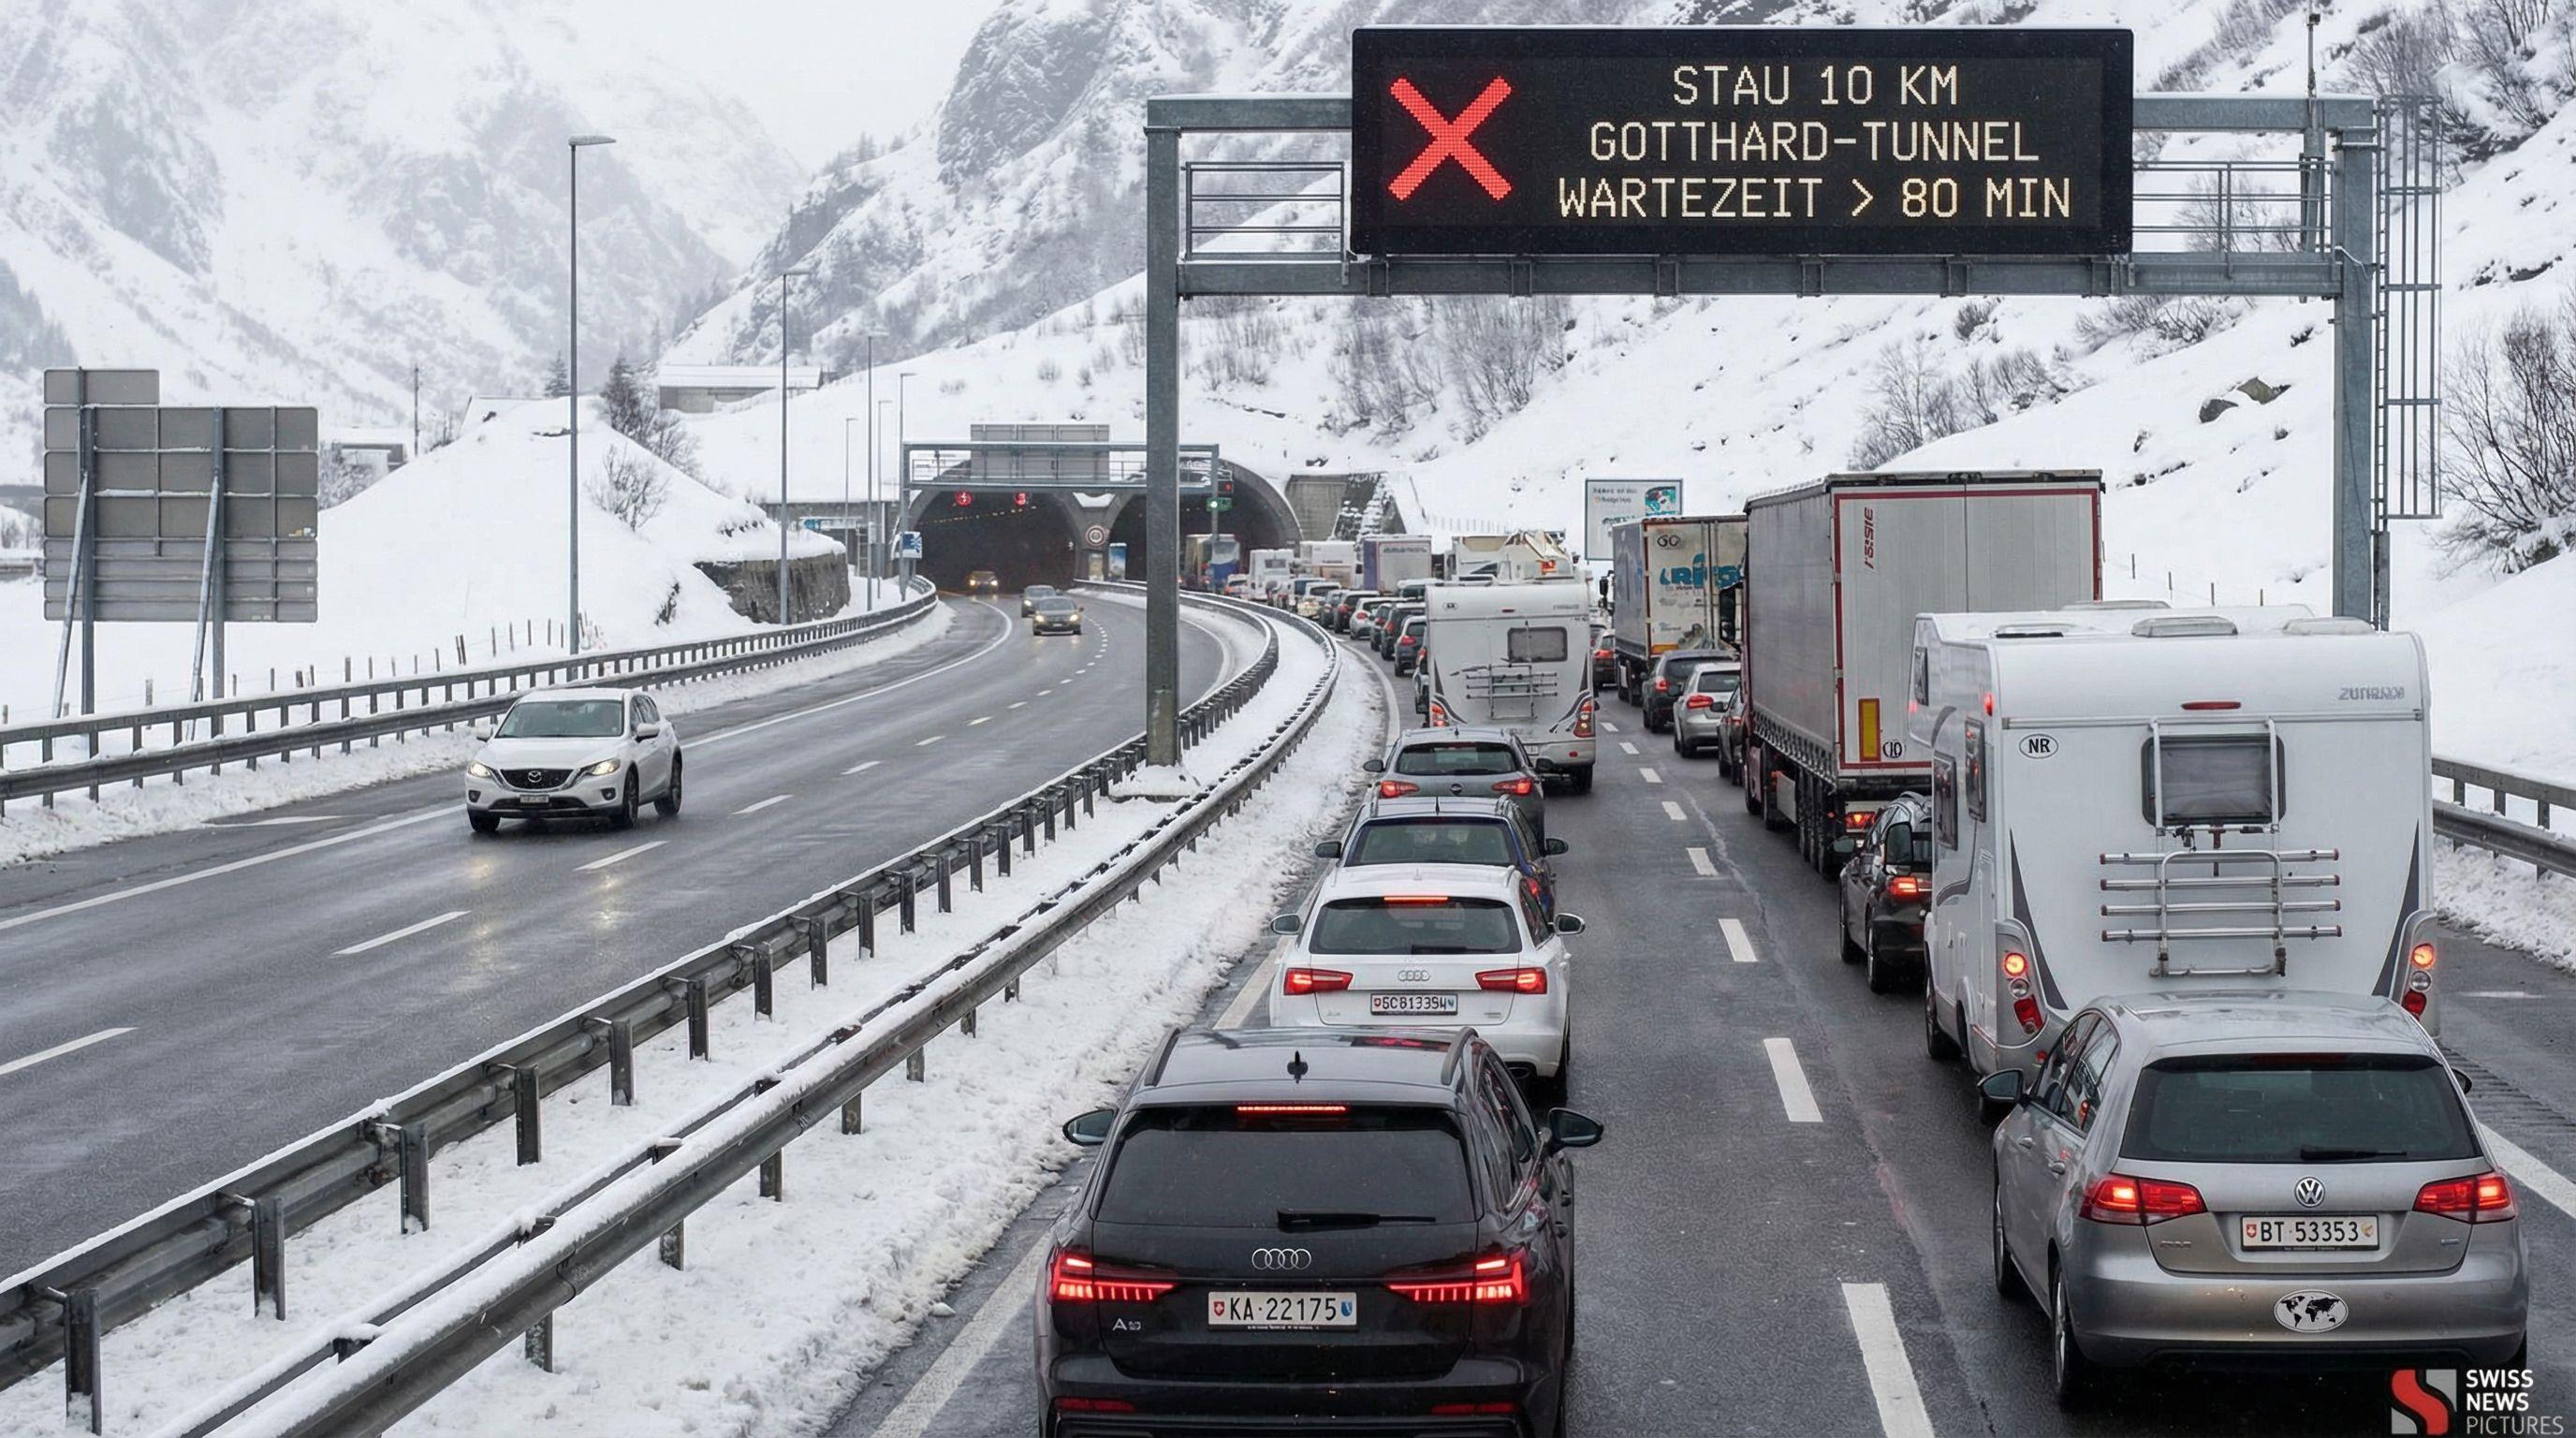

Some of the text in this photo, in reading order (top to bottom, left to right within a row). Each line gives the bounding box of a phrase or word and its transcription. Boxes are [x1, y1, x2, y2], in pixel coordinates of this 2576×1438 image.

[1673, 65, 1957, 106] STAU 10 KM
[1590, 121, 2040, 162] GOTTHARD-TUNNEL
[1559, 177, 2070, 218] WARTEZEIT > 80 MIN
[2028, 738, 2051, 754] NR
